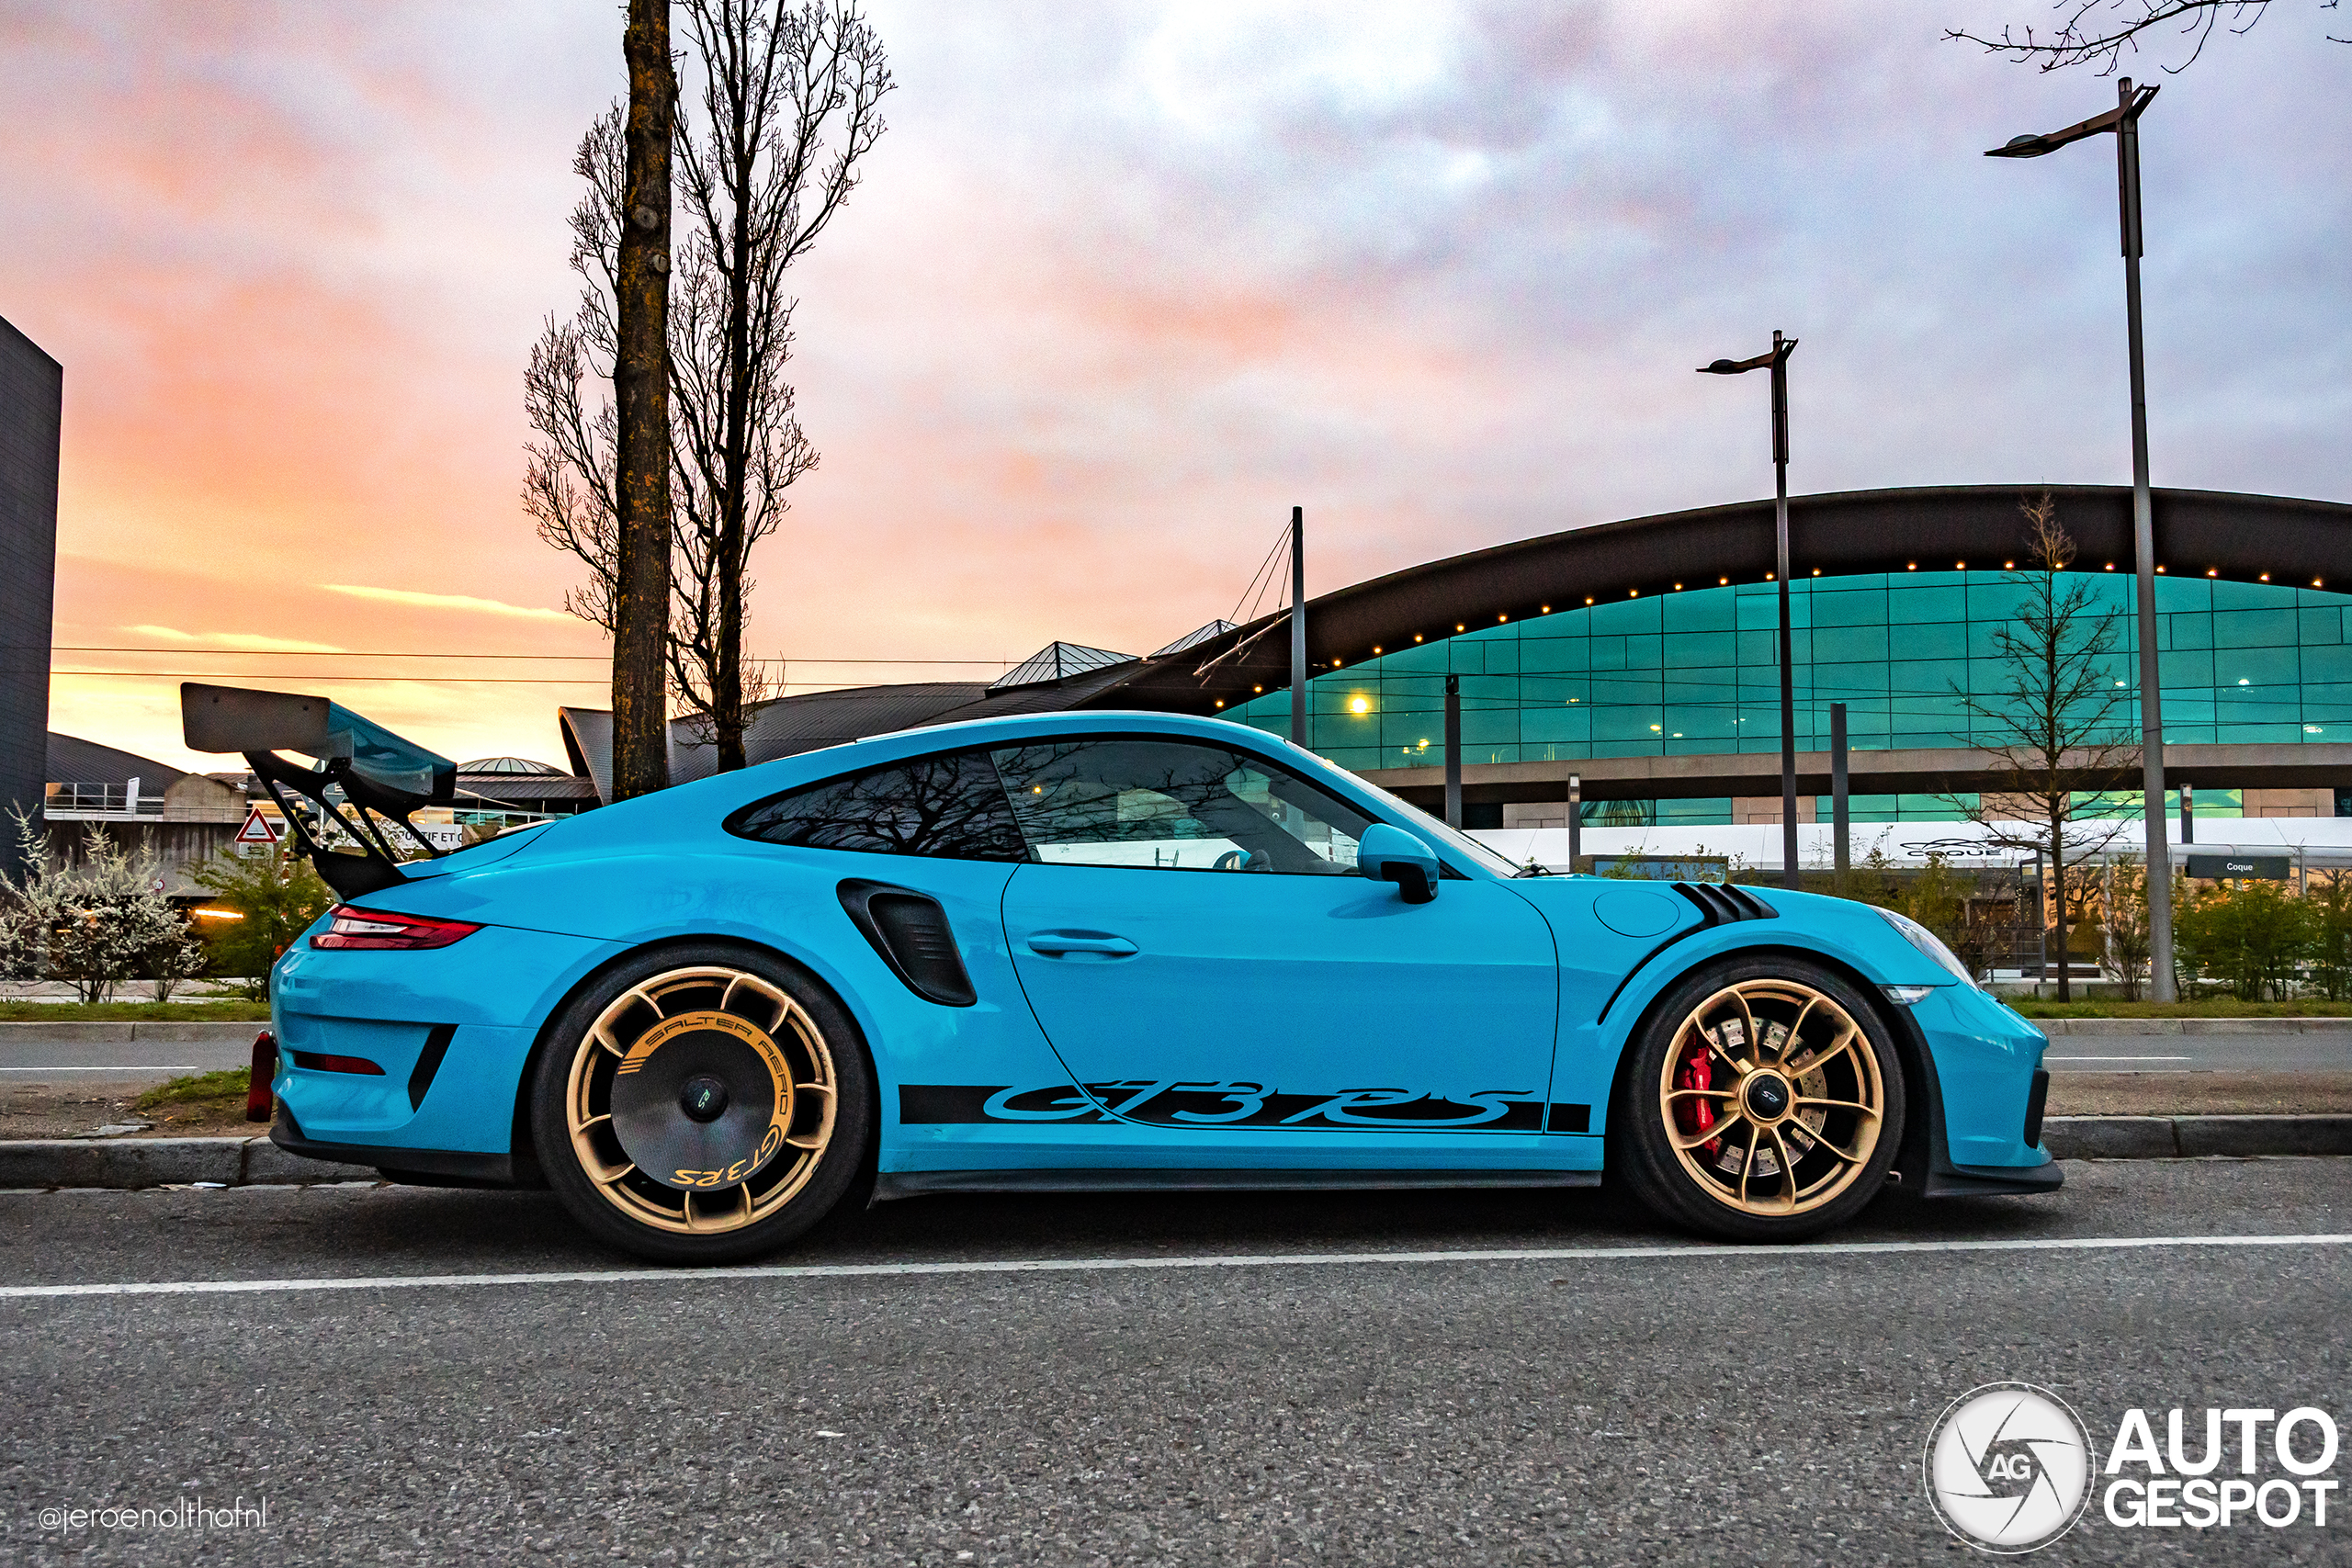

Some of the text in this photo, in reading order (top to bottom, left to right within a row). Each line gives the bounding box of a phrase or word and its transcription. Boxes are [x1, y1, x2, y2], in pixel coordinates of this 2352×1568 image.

[441, 832, 455, 841] ET
[2226, 863, 2254, 872] Coque
[645, 1016, 788, 1115] SALTER AERO
[983, 1080, 1264, 1123] GT3
